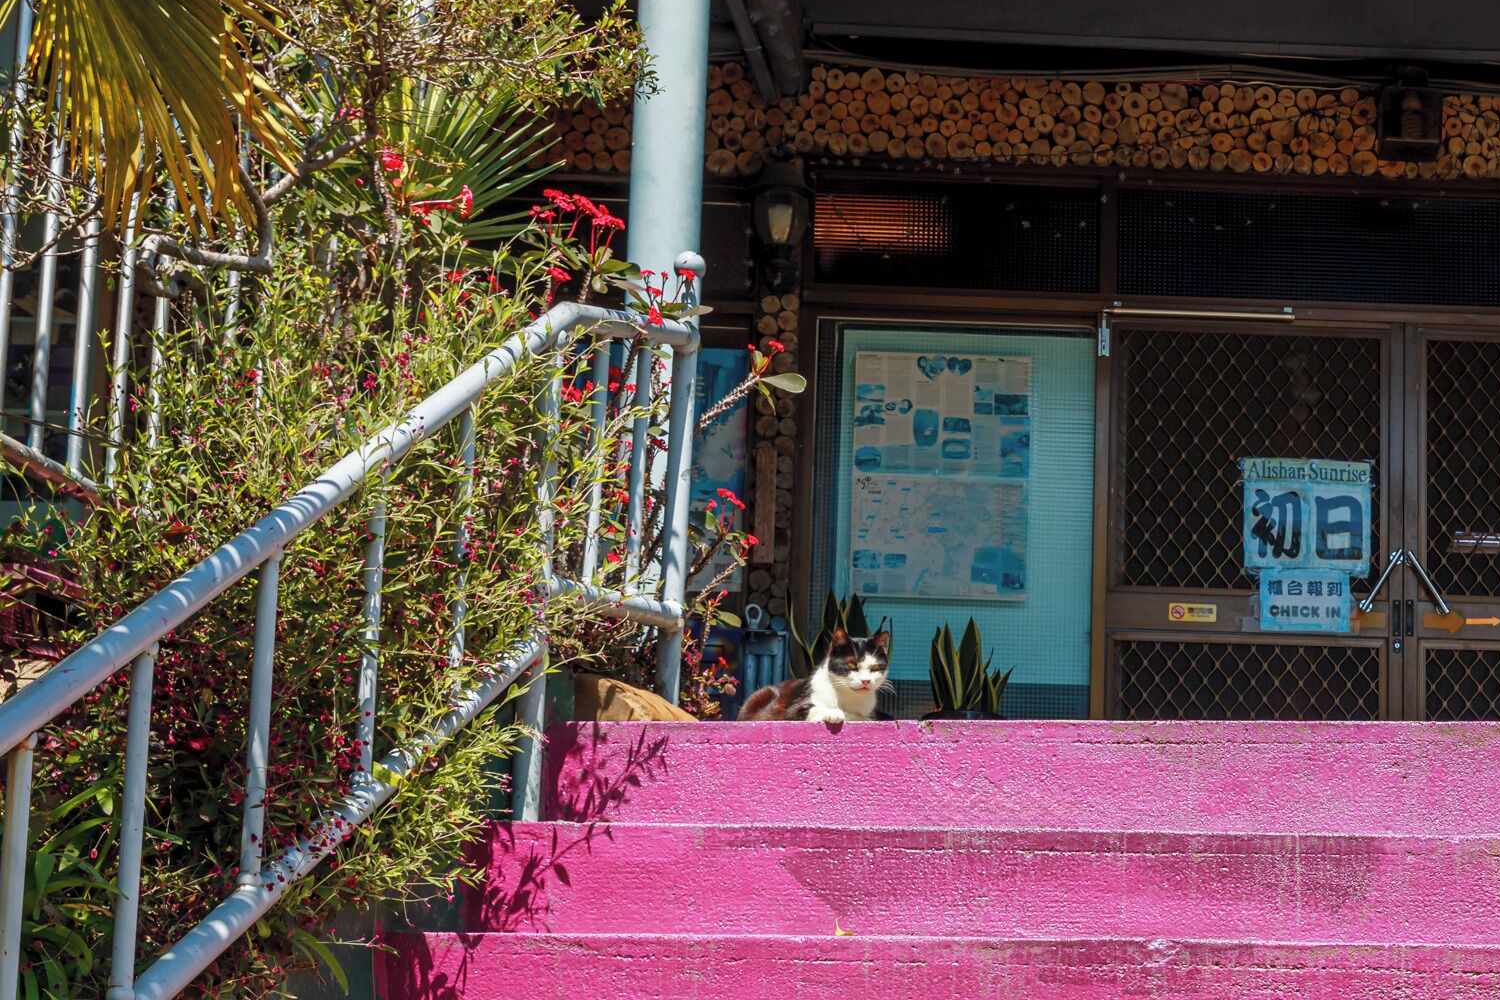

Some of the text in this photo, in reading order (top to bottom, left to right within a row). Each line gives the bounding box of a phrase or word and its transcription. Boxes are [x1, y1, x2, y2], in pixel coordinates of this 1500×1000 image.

[1248, 460, 1367, 482] Alishan Sunrise
[1251, 488, 1363, 560] 初日
[1267, 579, 1344, 597] 櫃台報到
[1268, 604, 1342, 619] CHECK IN
